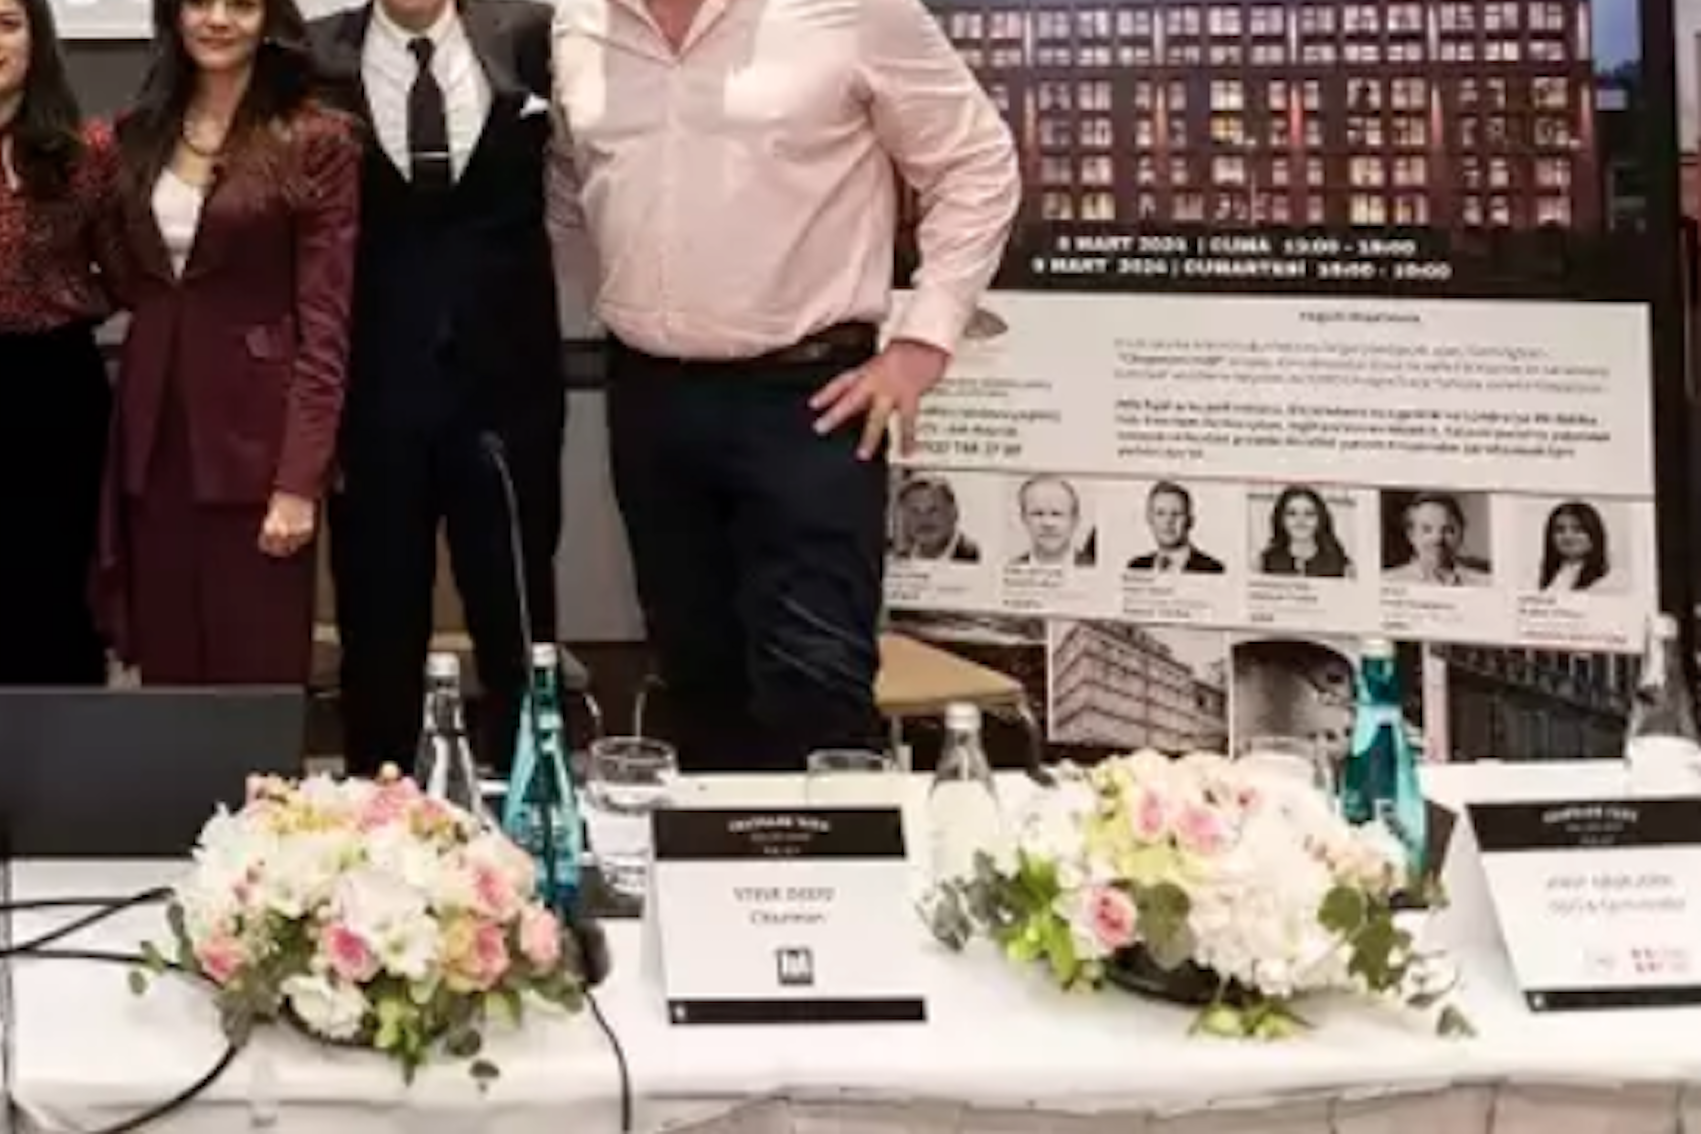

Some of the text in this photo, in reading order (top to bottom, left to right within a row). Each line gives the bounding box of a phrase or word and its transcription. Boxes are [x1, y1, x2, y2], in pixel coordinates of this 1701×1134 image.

[1074, 236, 1132, 251] MART
[1209, 236, 1271, 253] CUMA
[1049, 257, 1107, 274] MART
